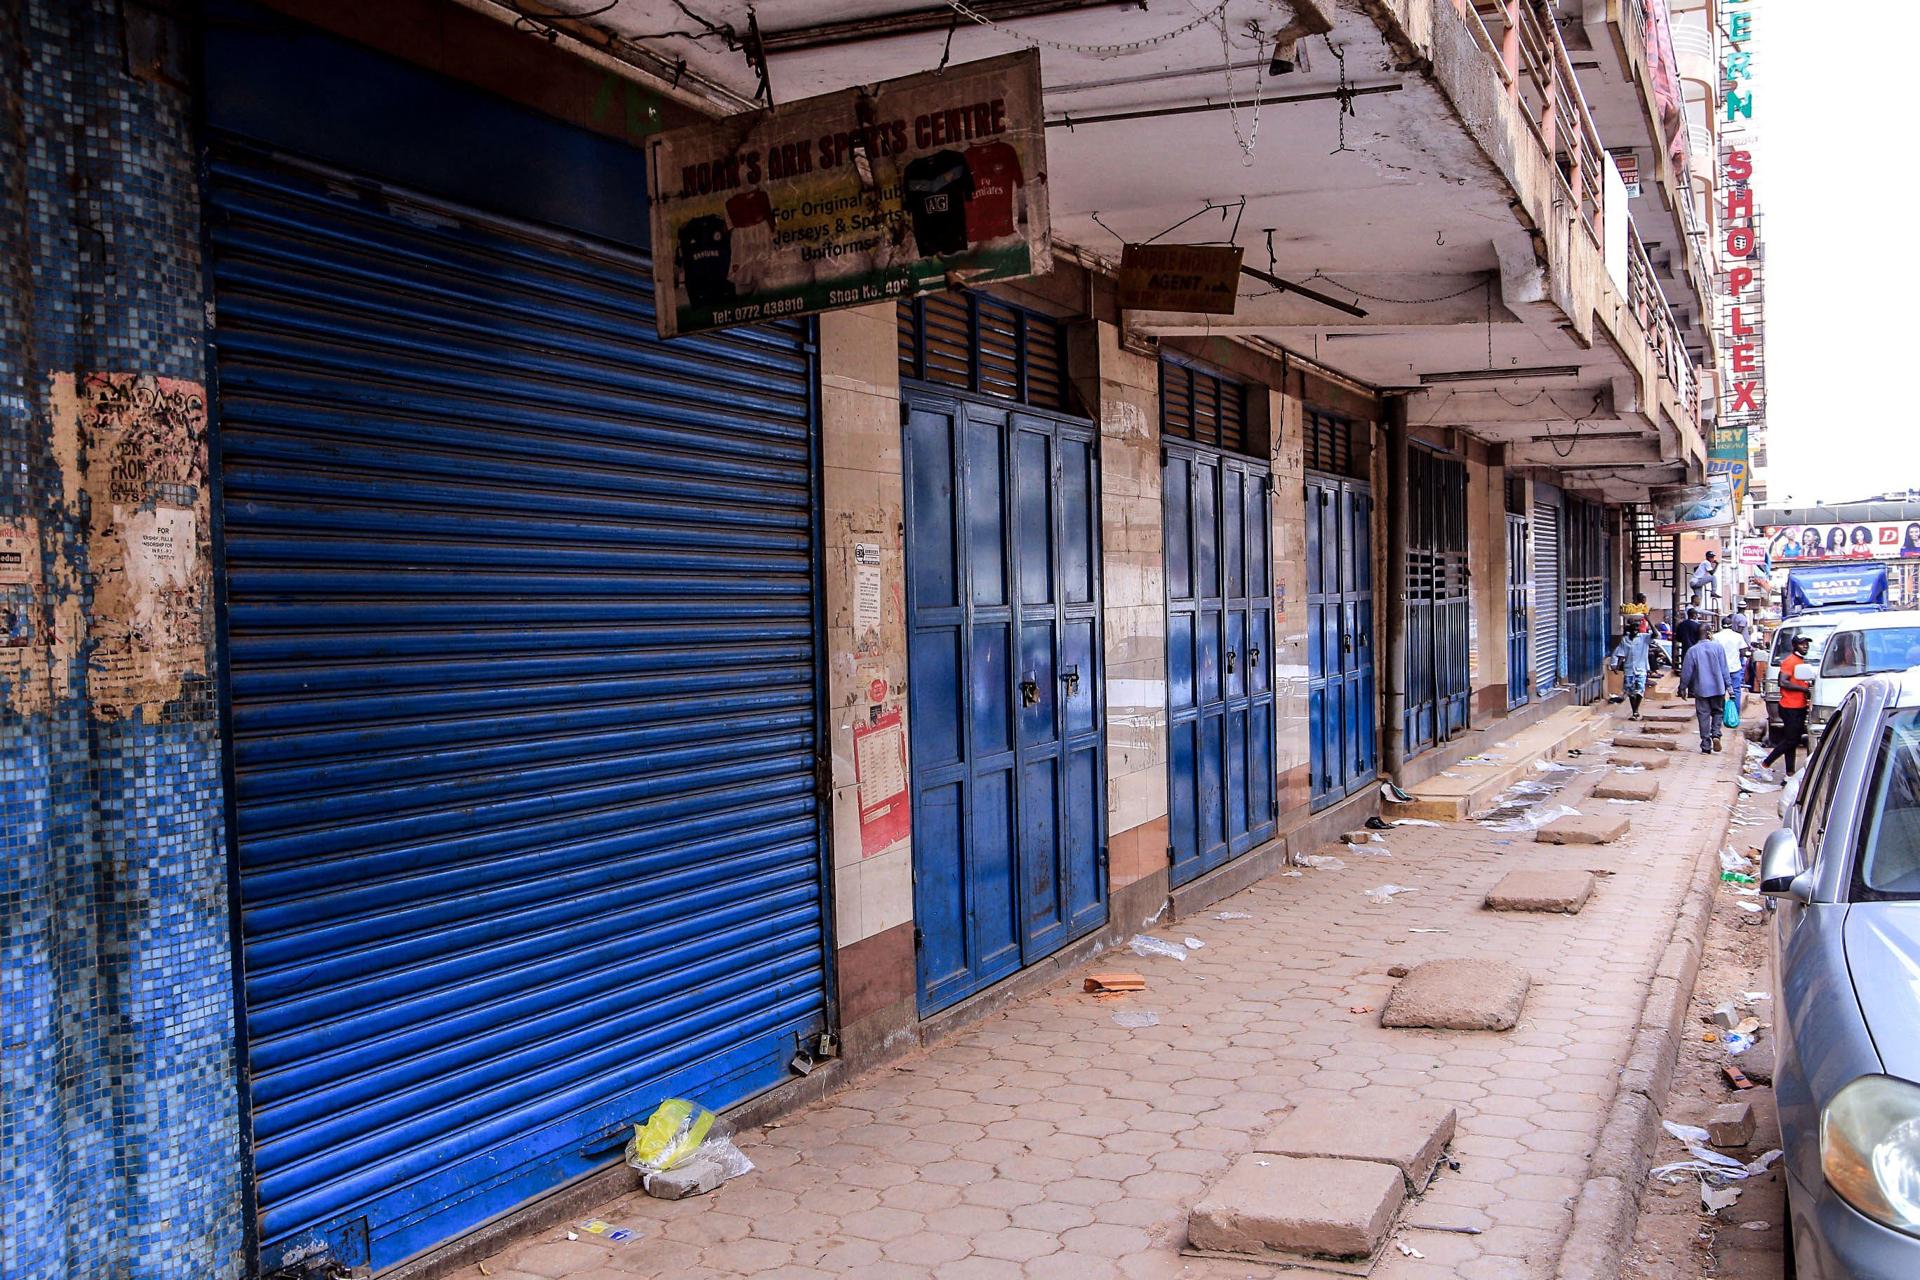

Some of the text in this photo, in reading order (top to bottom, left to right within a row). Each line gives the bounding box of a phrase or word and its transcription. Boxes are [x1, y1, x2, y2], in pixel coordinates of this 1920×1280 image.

[1727, 0, 1752, 121] ERN
[768, 139, 813, 181] ARK
[914, 98, 1007, 150] CENTRE
[771, 207, 797, 222] For
[801, 192, 863, 218] Original
[772, 224, 830, 246] Jerseys
[835, 217, 847, 234] &
[801, 239, 872, 262] Uniforms
[1147, 274, 1203, 291] AGENT
[1726, 150, 1758, 413] SHOPLEX
[713, 308, 732, 325] Tel:
[735, 303, 760, 320] 0772
